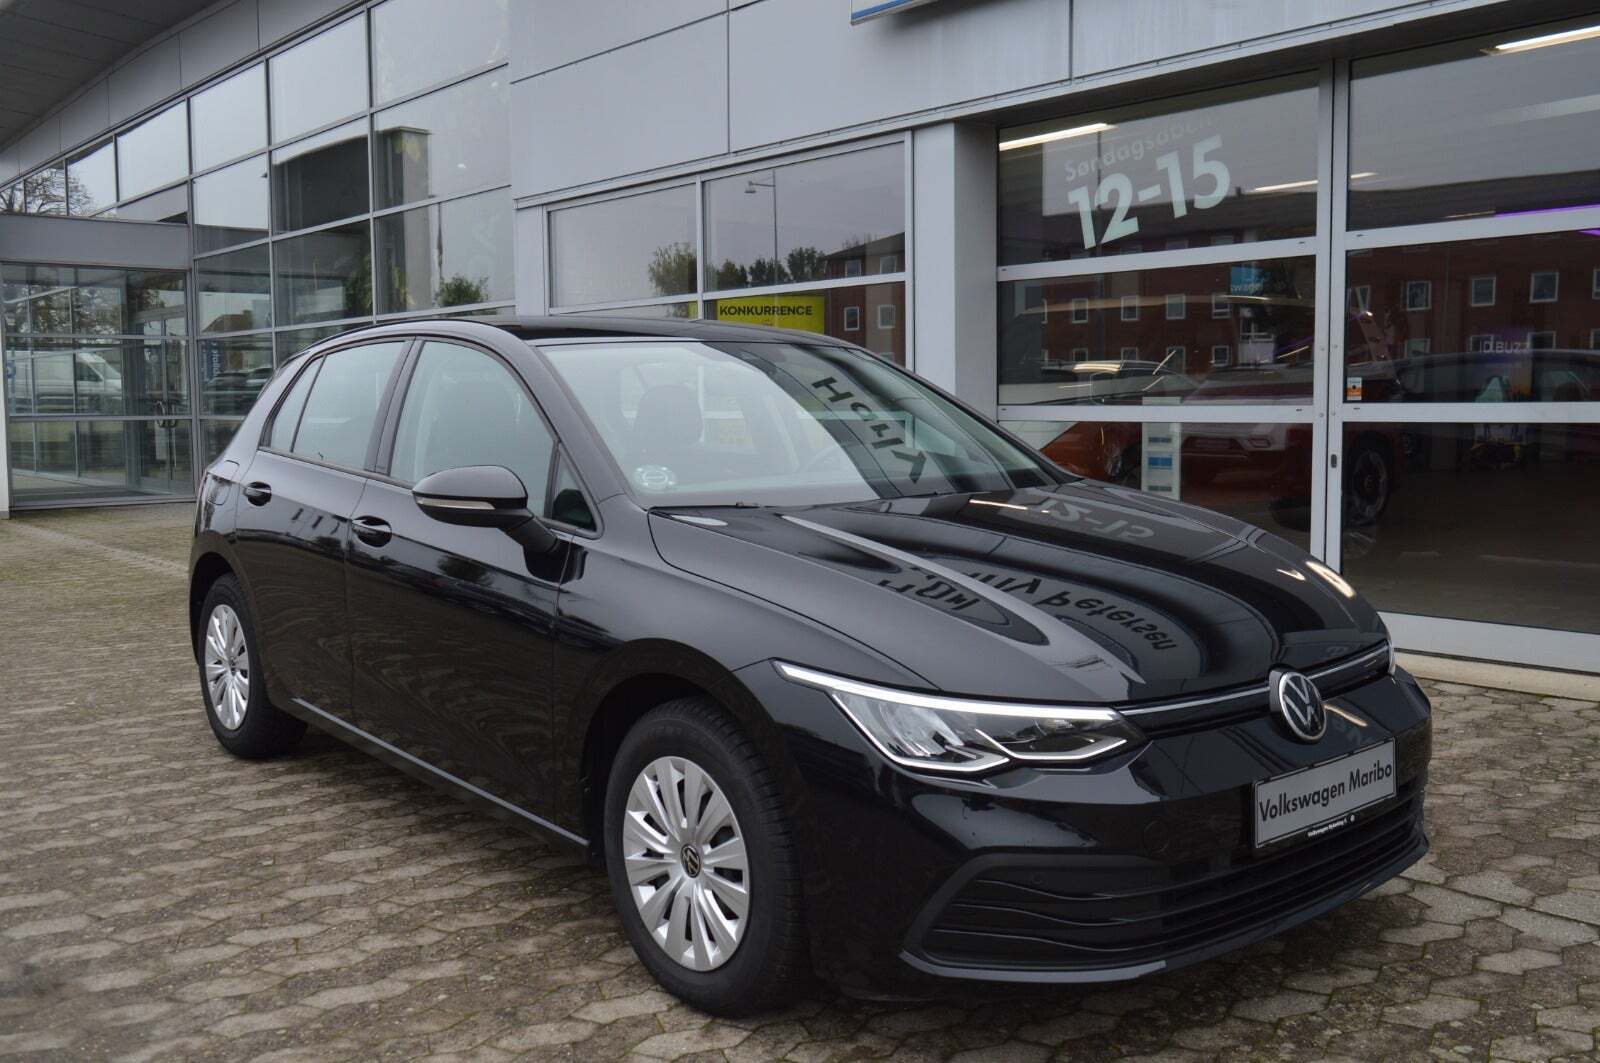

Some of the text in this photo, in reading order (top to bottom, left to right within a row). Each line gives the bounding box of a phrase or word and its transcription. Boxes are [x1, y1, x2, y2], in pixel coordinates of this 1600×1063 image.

[1067, 134, 1231, 250] 12-15
[719, 304, 813, 316] KONKURRENCE
[1259, 760, 1393, 822] Volkswagen Maribo
